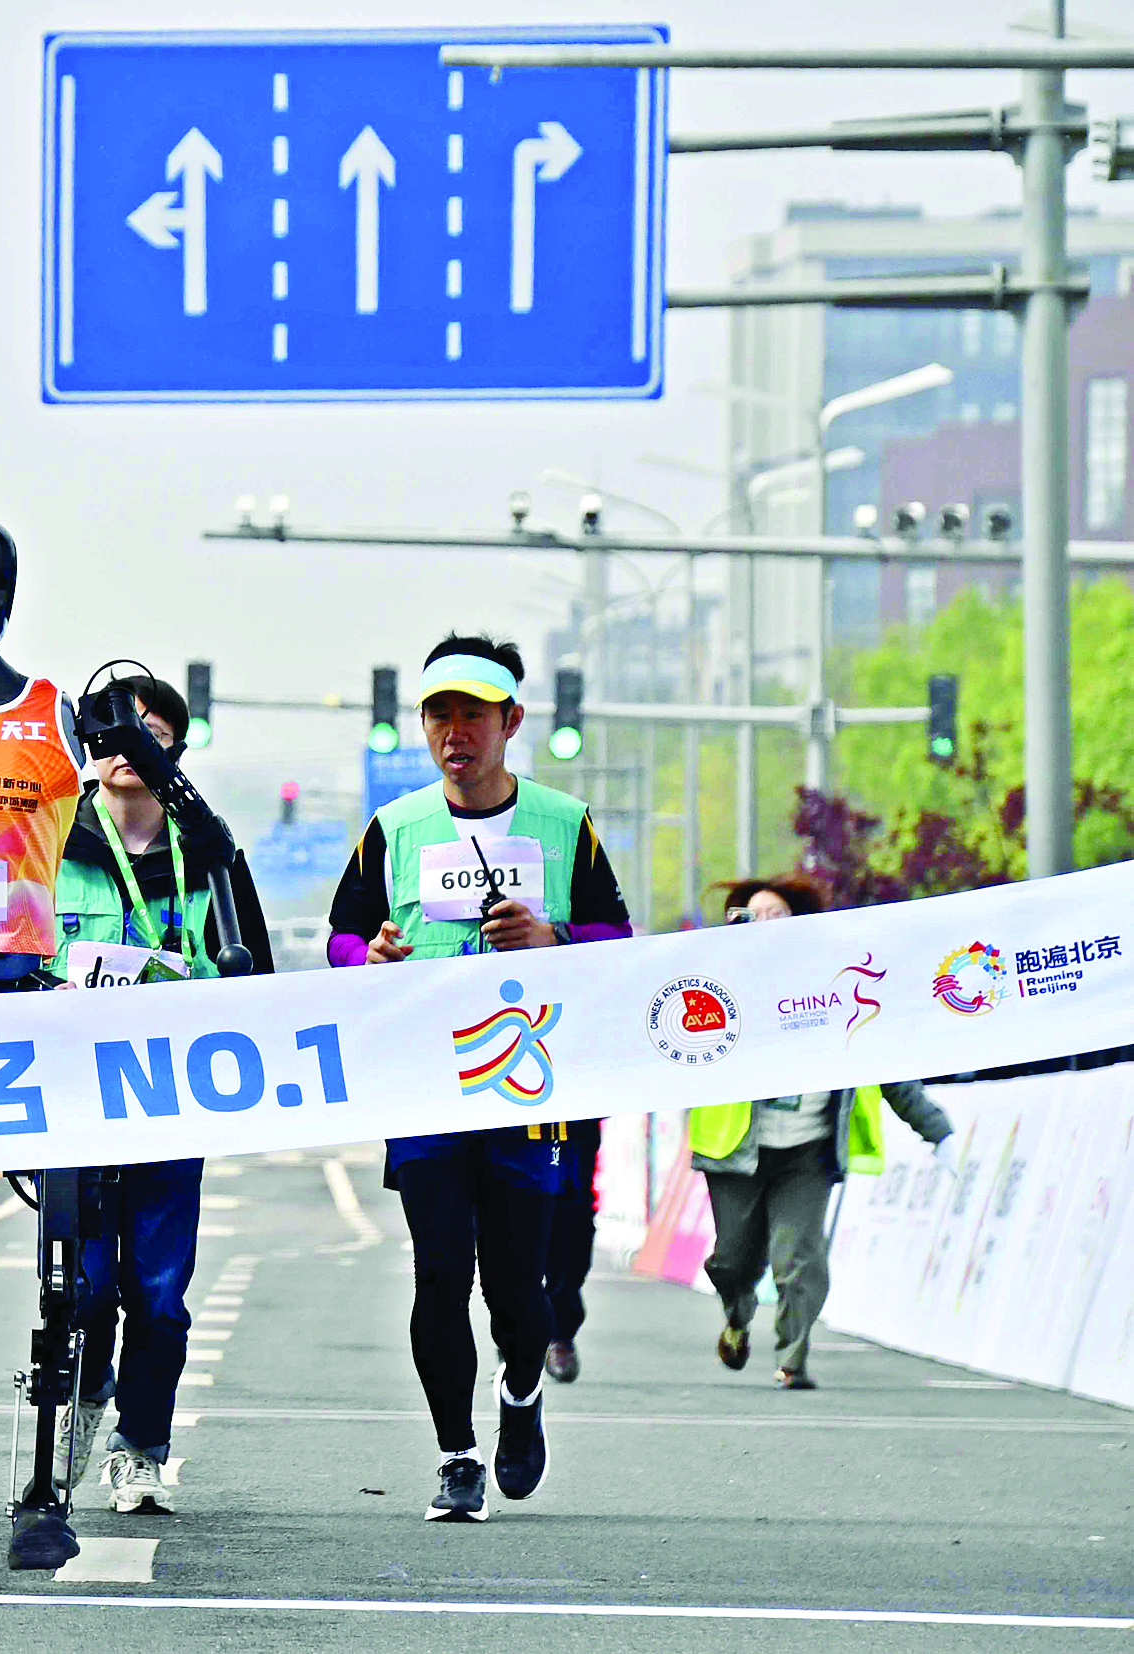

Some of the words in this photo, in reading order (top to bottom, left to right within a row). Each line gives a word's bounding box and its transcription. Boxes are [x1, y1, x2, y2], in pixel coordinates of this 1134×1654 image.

[1, 720, 46, 741] 天工
[441, 867, 522, 890] 60901
[1015, 935, 1122, 975] 跑遍北京
[1026, 970, 1083, 986] Running
[1028, 982, 1077, 996] Beijing
[650, 997, 665, 1030] CHINESE
[662, 978, 700, 999] ATHLETICS
[702, 980, 738, 1020] ASSOCIATION
[778, 992, 842, 1014] CHINA
[779, 1010, 828, 1021] MARATHON
[94, 1023, 348, 1120] NO.1
